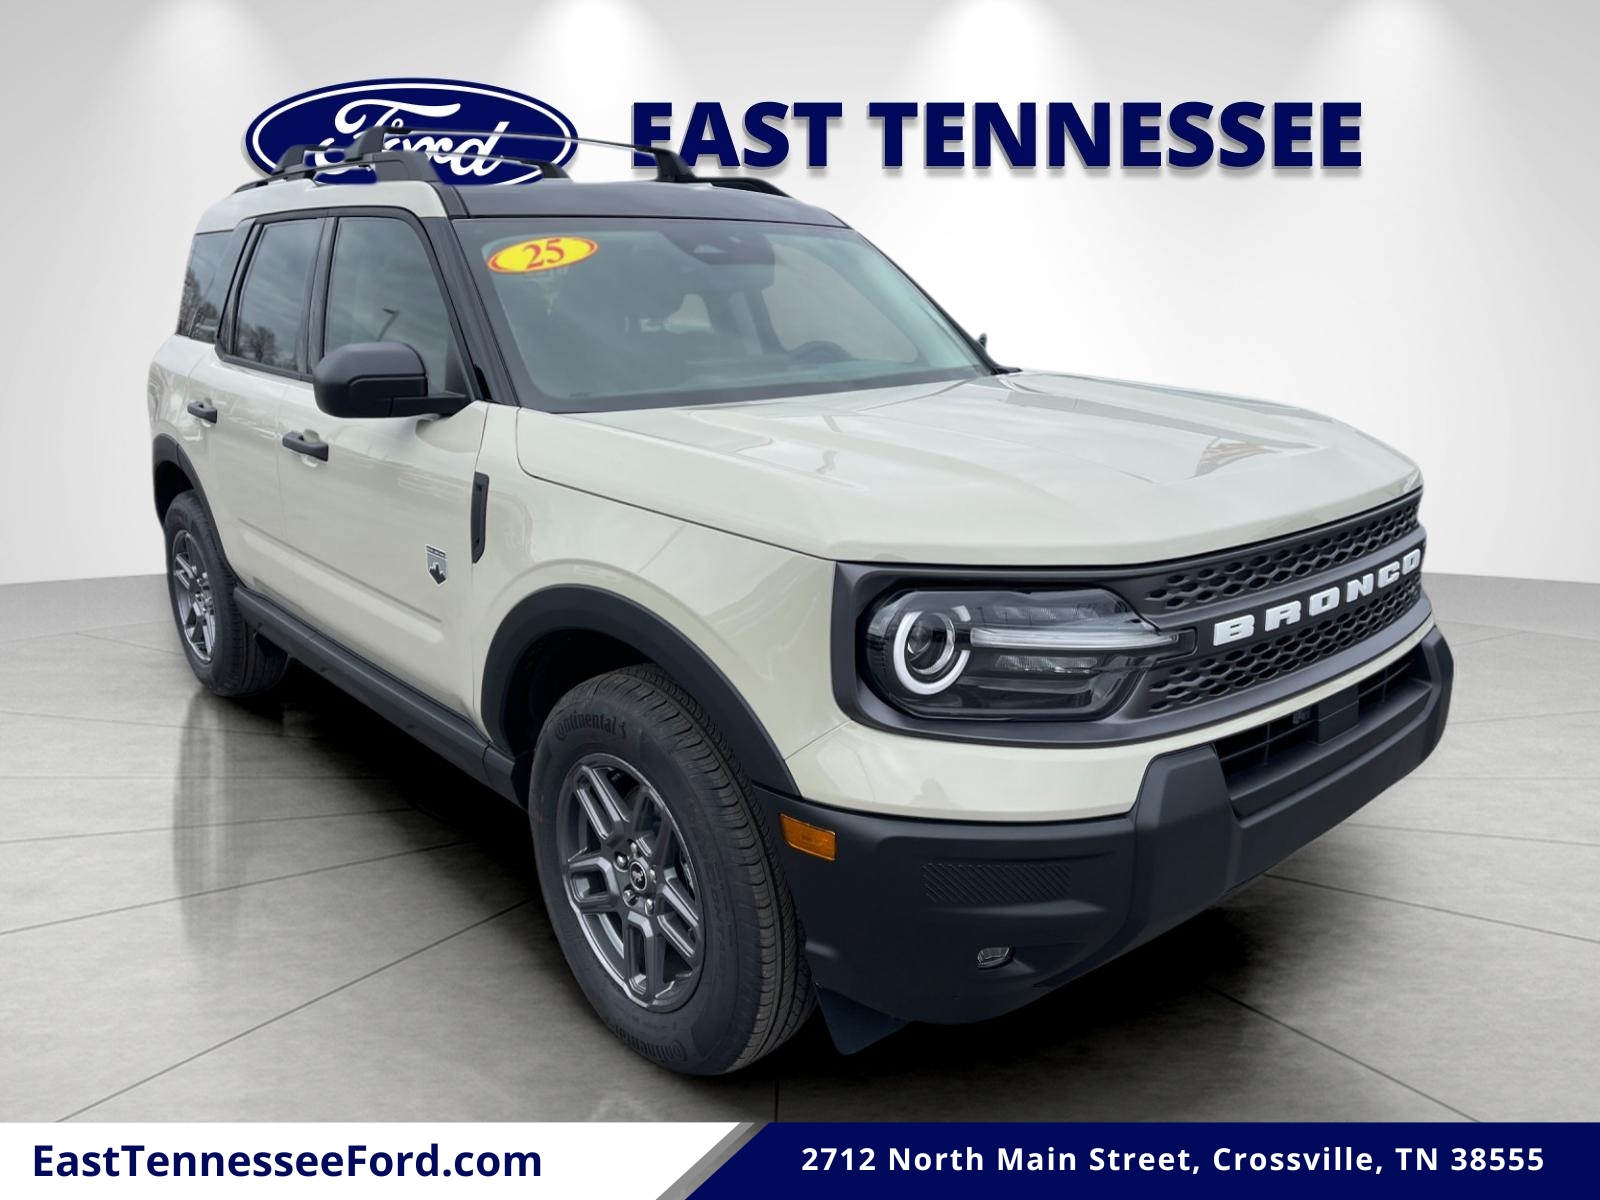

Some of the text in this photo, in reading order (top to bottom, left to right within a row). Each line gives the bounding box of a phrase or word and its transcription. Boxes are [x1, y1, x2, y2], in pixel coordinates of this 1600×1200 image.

[632, 101, 1362, 168] EAST TENNESSEE
[522, 238, 565, 269] 25
[1213, 548, 1421, 646] BRONCO
[554, 709, 617, 741] Continental
